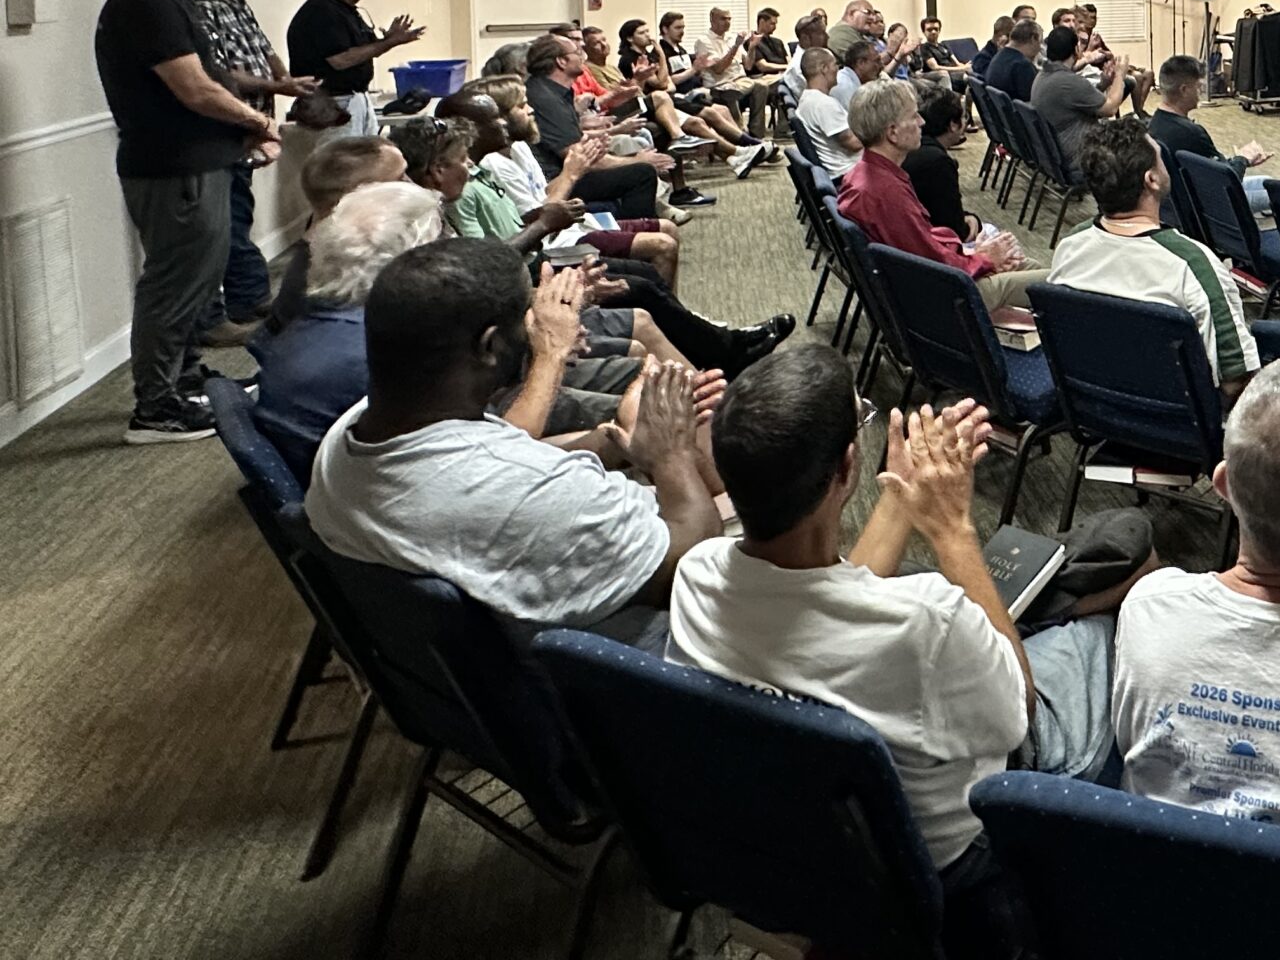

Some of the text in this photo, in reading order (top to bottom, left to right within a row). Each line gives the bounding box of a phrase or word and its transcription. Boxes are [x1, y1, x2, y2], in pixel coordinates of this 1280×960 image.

[990, 556, 1022, 571] HOLY
[1191, 683, 1228, 703] 2026
[1177, 702, 1239, 726] Exclusive
[1202, 751, 1241, 769] Central
[1243, 758, 1280, 777] Florida
[1233, 791, 1280, 811] Sponsor
